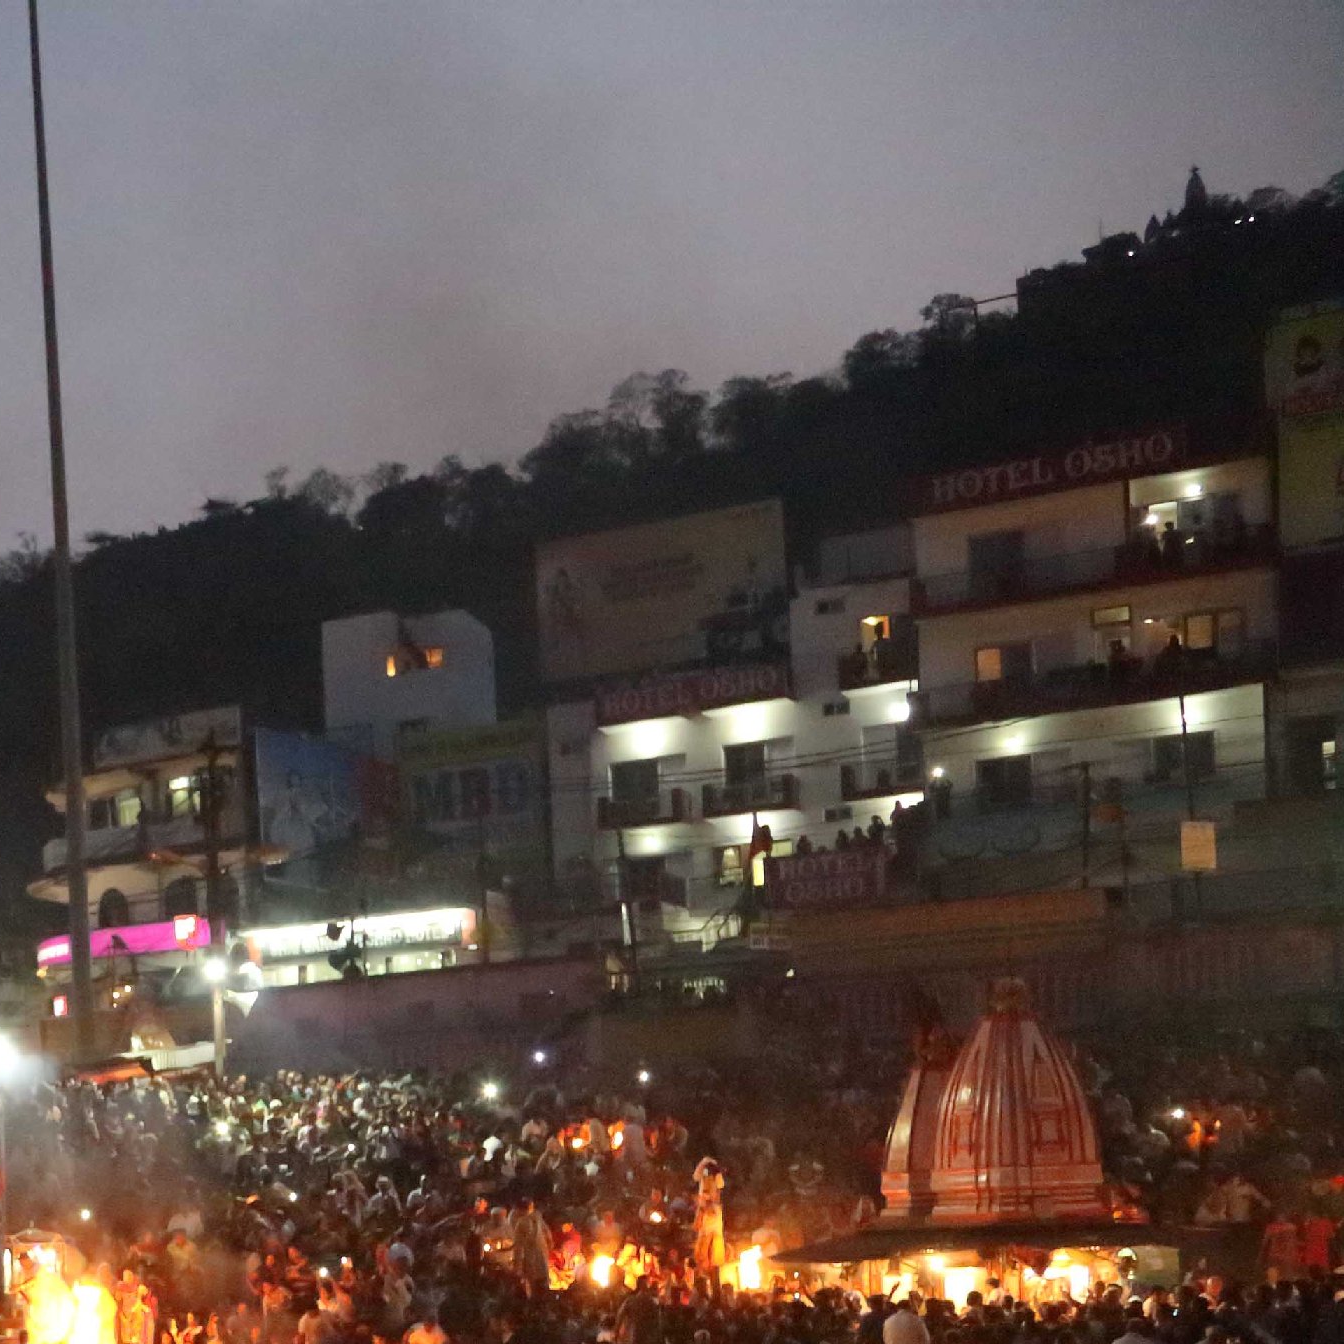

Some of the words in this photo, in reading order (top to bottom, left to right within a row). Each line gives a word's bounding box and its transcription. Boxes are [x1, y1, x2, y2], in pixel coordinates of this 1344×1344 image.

[932, 456, 1053, 501] HOTEL
[1064, 431, 1172, 478] OSHO
[605, 683, 692, 718] HOTEL
[700, 666, 776, 699] OSHO
